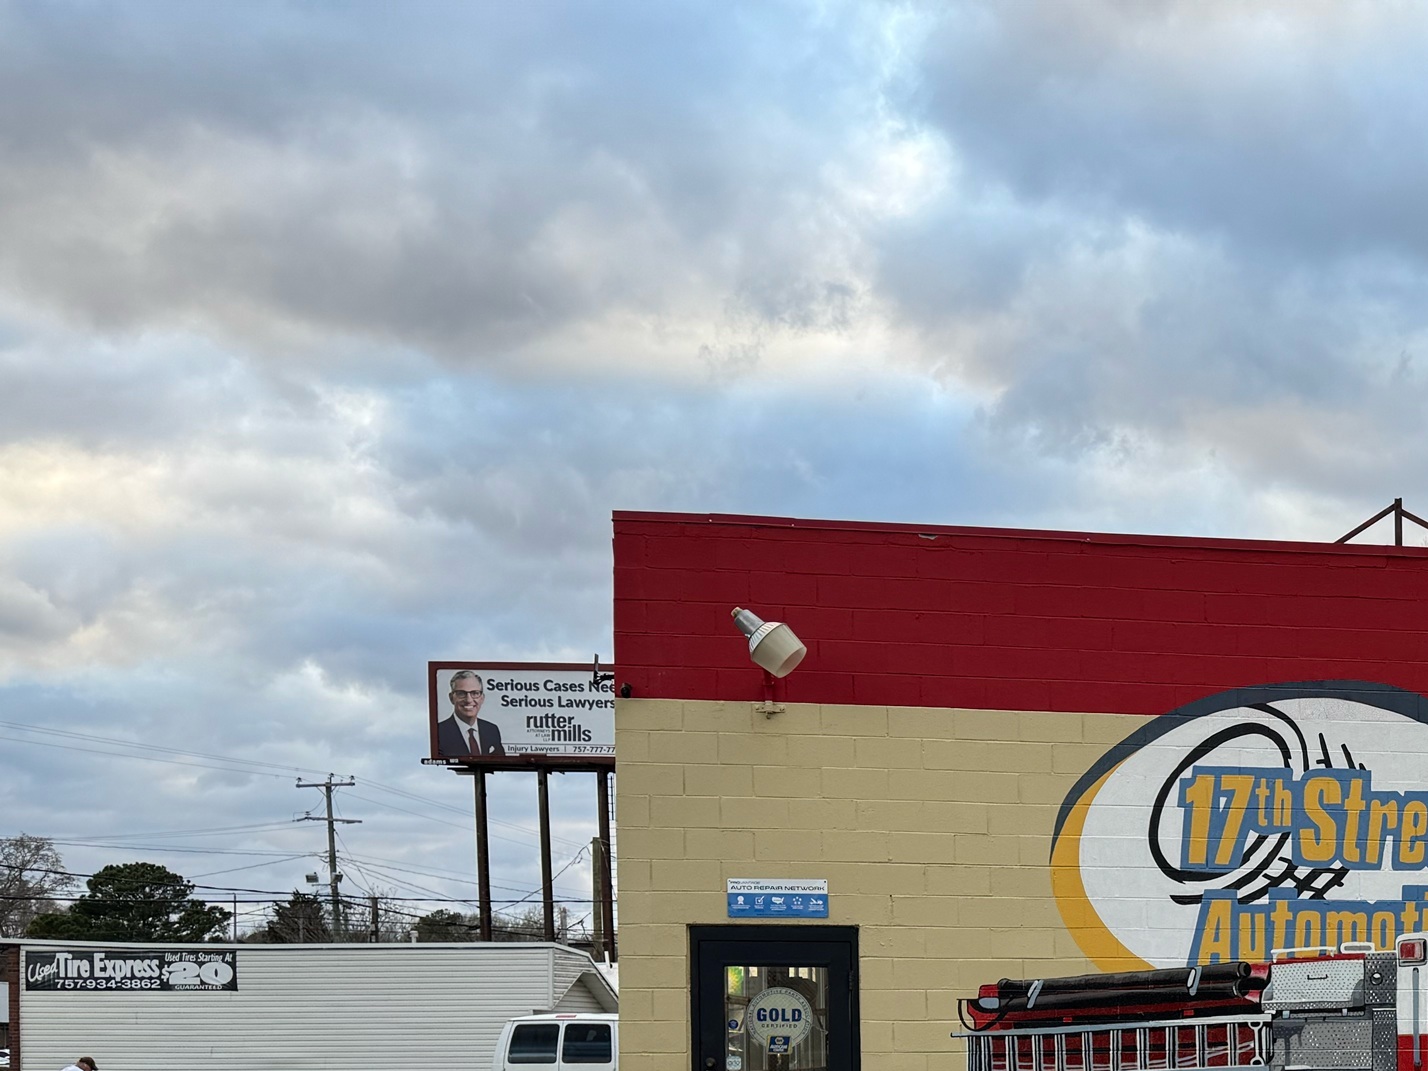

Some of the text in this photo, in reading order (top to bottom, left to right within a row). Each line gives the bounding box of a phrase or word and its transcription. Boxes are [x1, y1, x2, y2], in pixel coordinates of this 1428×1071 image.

[486, 678, 539, 692] Serious
[543, 679, 585, 692] Cases
[501, 695, 615, 711] Serious Lawyers
[526, 713, 575, 728] rutter
[551, 724, 592, 742] mills
[508, 745, 528, 753] Injury
[530, 745, 560, 753] Lawyers
[1185, 774, 1293, 866] 17th
[165, 953, 232, 963] Used Tires Starting At
[28, 952, 159, 983] Used Tire Express
[161, 961, 233, 985] $20
[55, 979, 161, 989] 757-934-3862
[757, 1008, 802, 1022] GOLD
